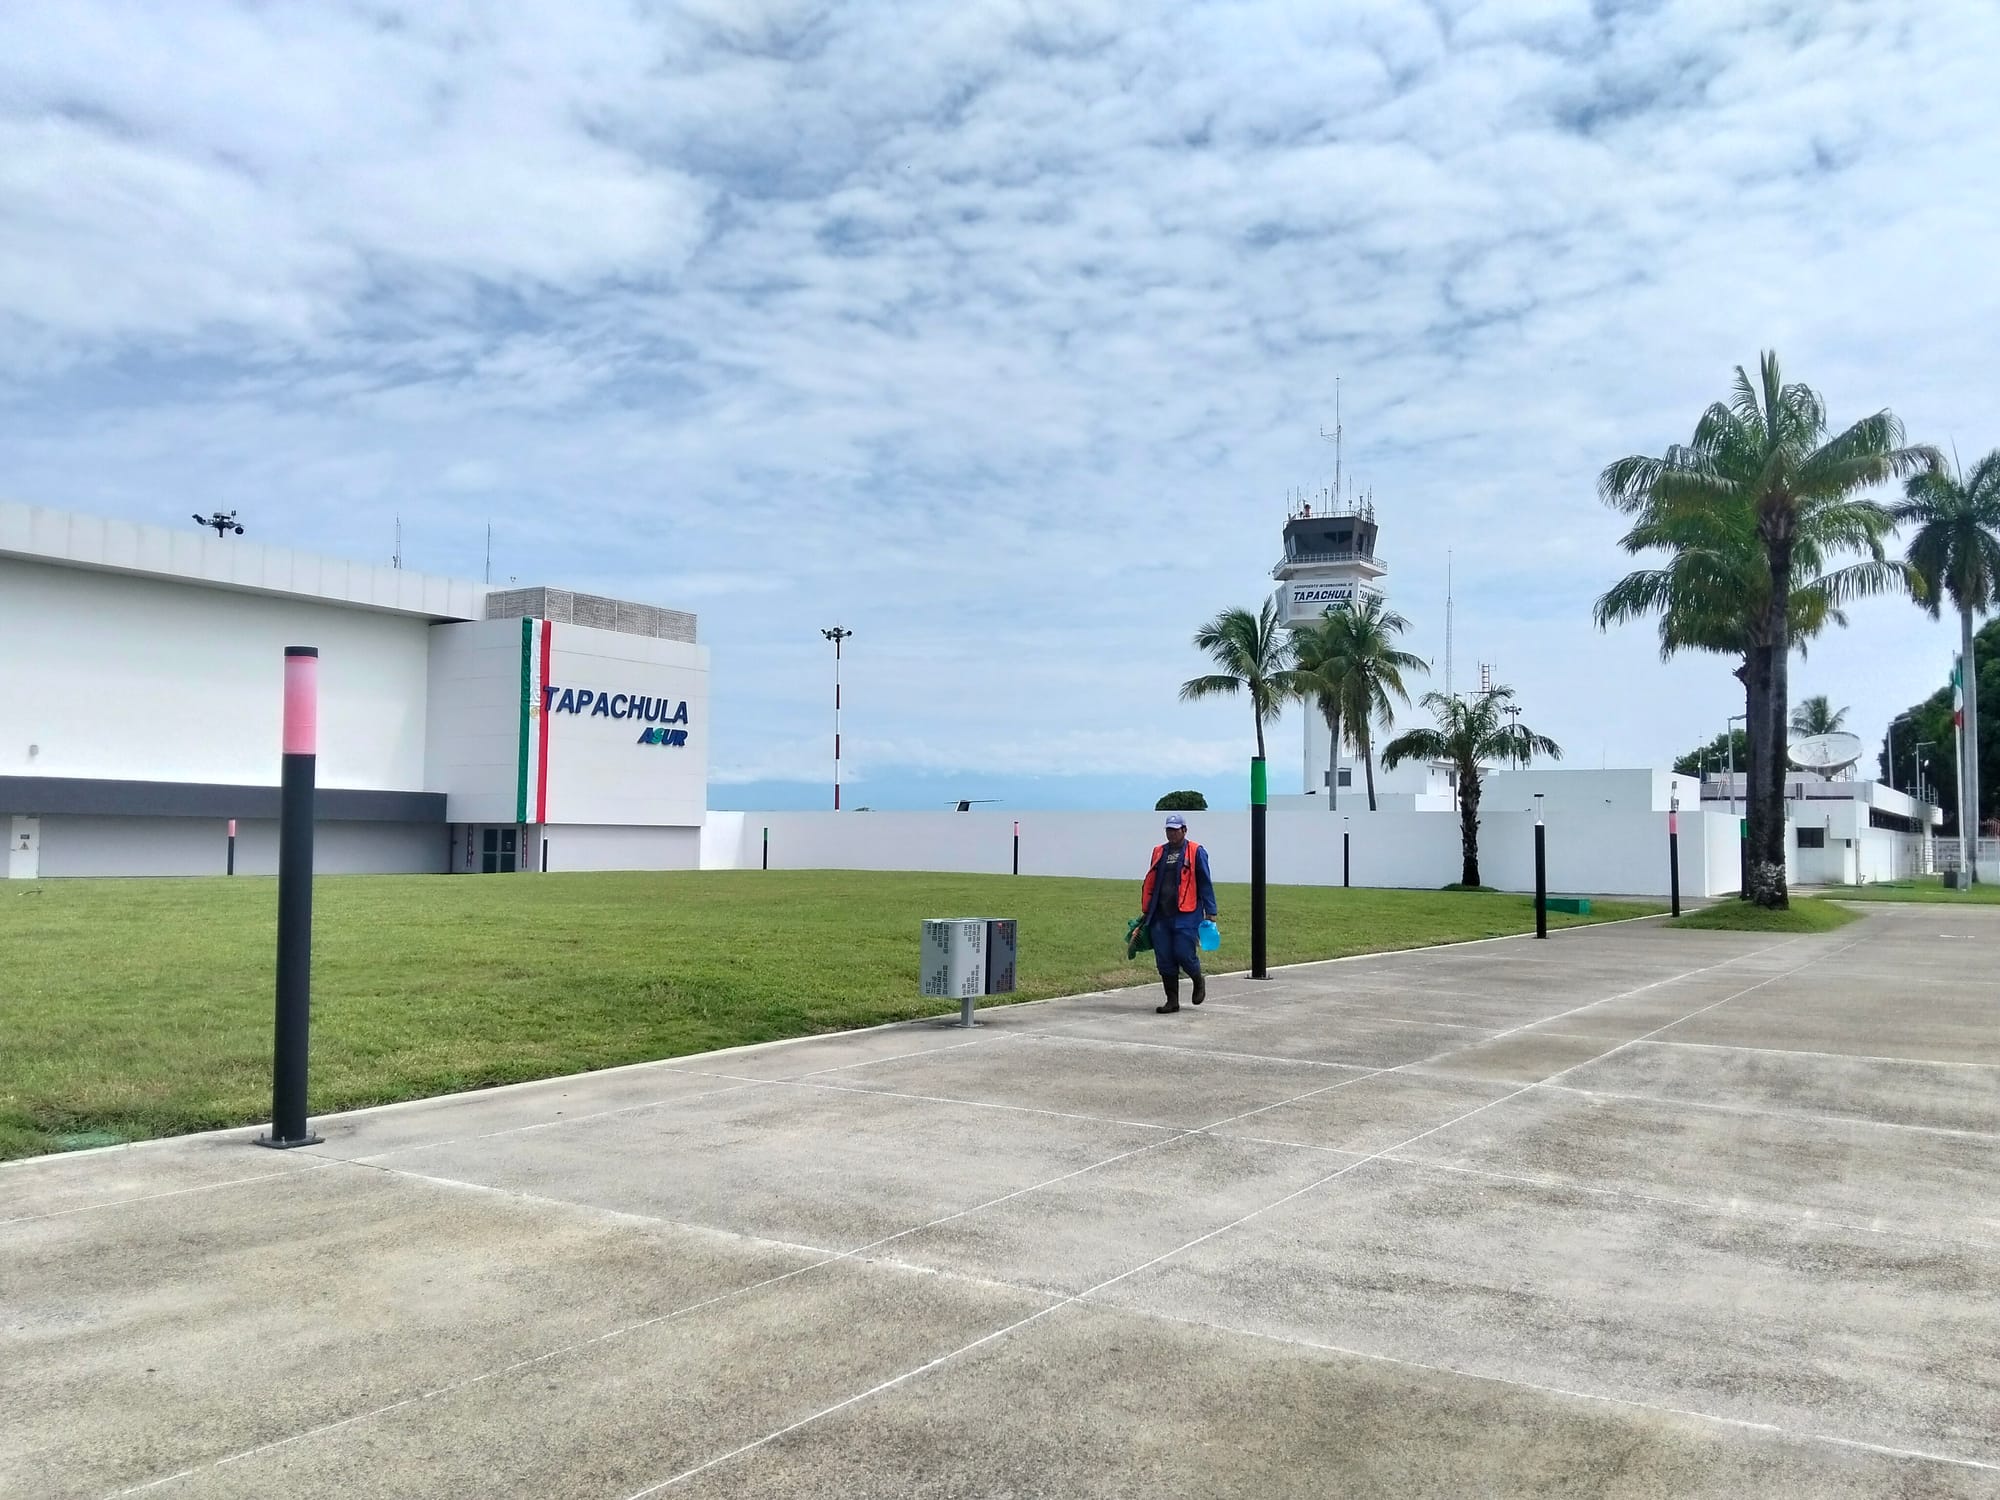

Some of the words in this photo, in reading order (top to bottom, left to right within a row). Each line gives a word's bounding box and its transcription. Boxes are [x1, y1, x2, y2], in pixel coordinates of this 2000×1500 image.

[1294, 590, 1352, 601] TAPACHULA
[543, 685, 689, 724] TAPACHULA
[637, 727, 688, 746] ASUR
